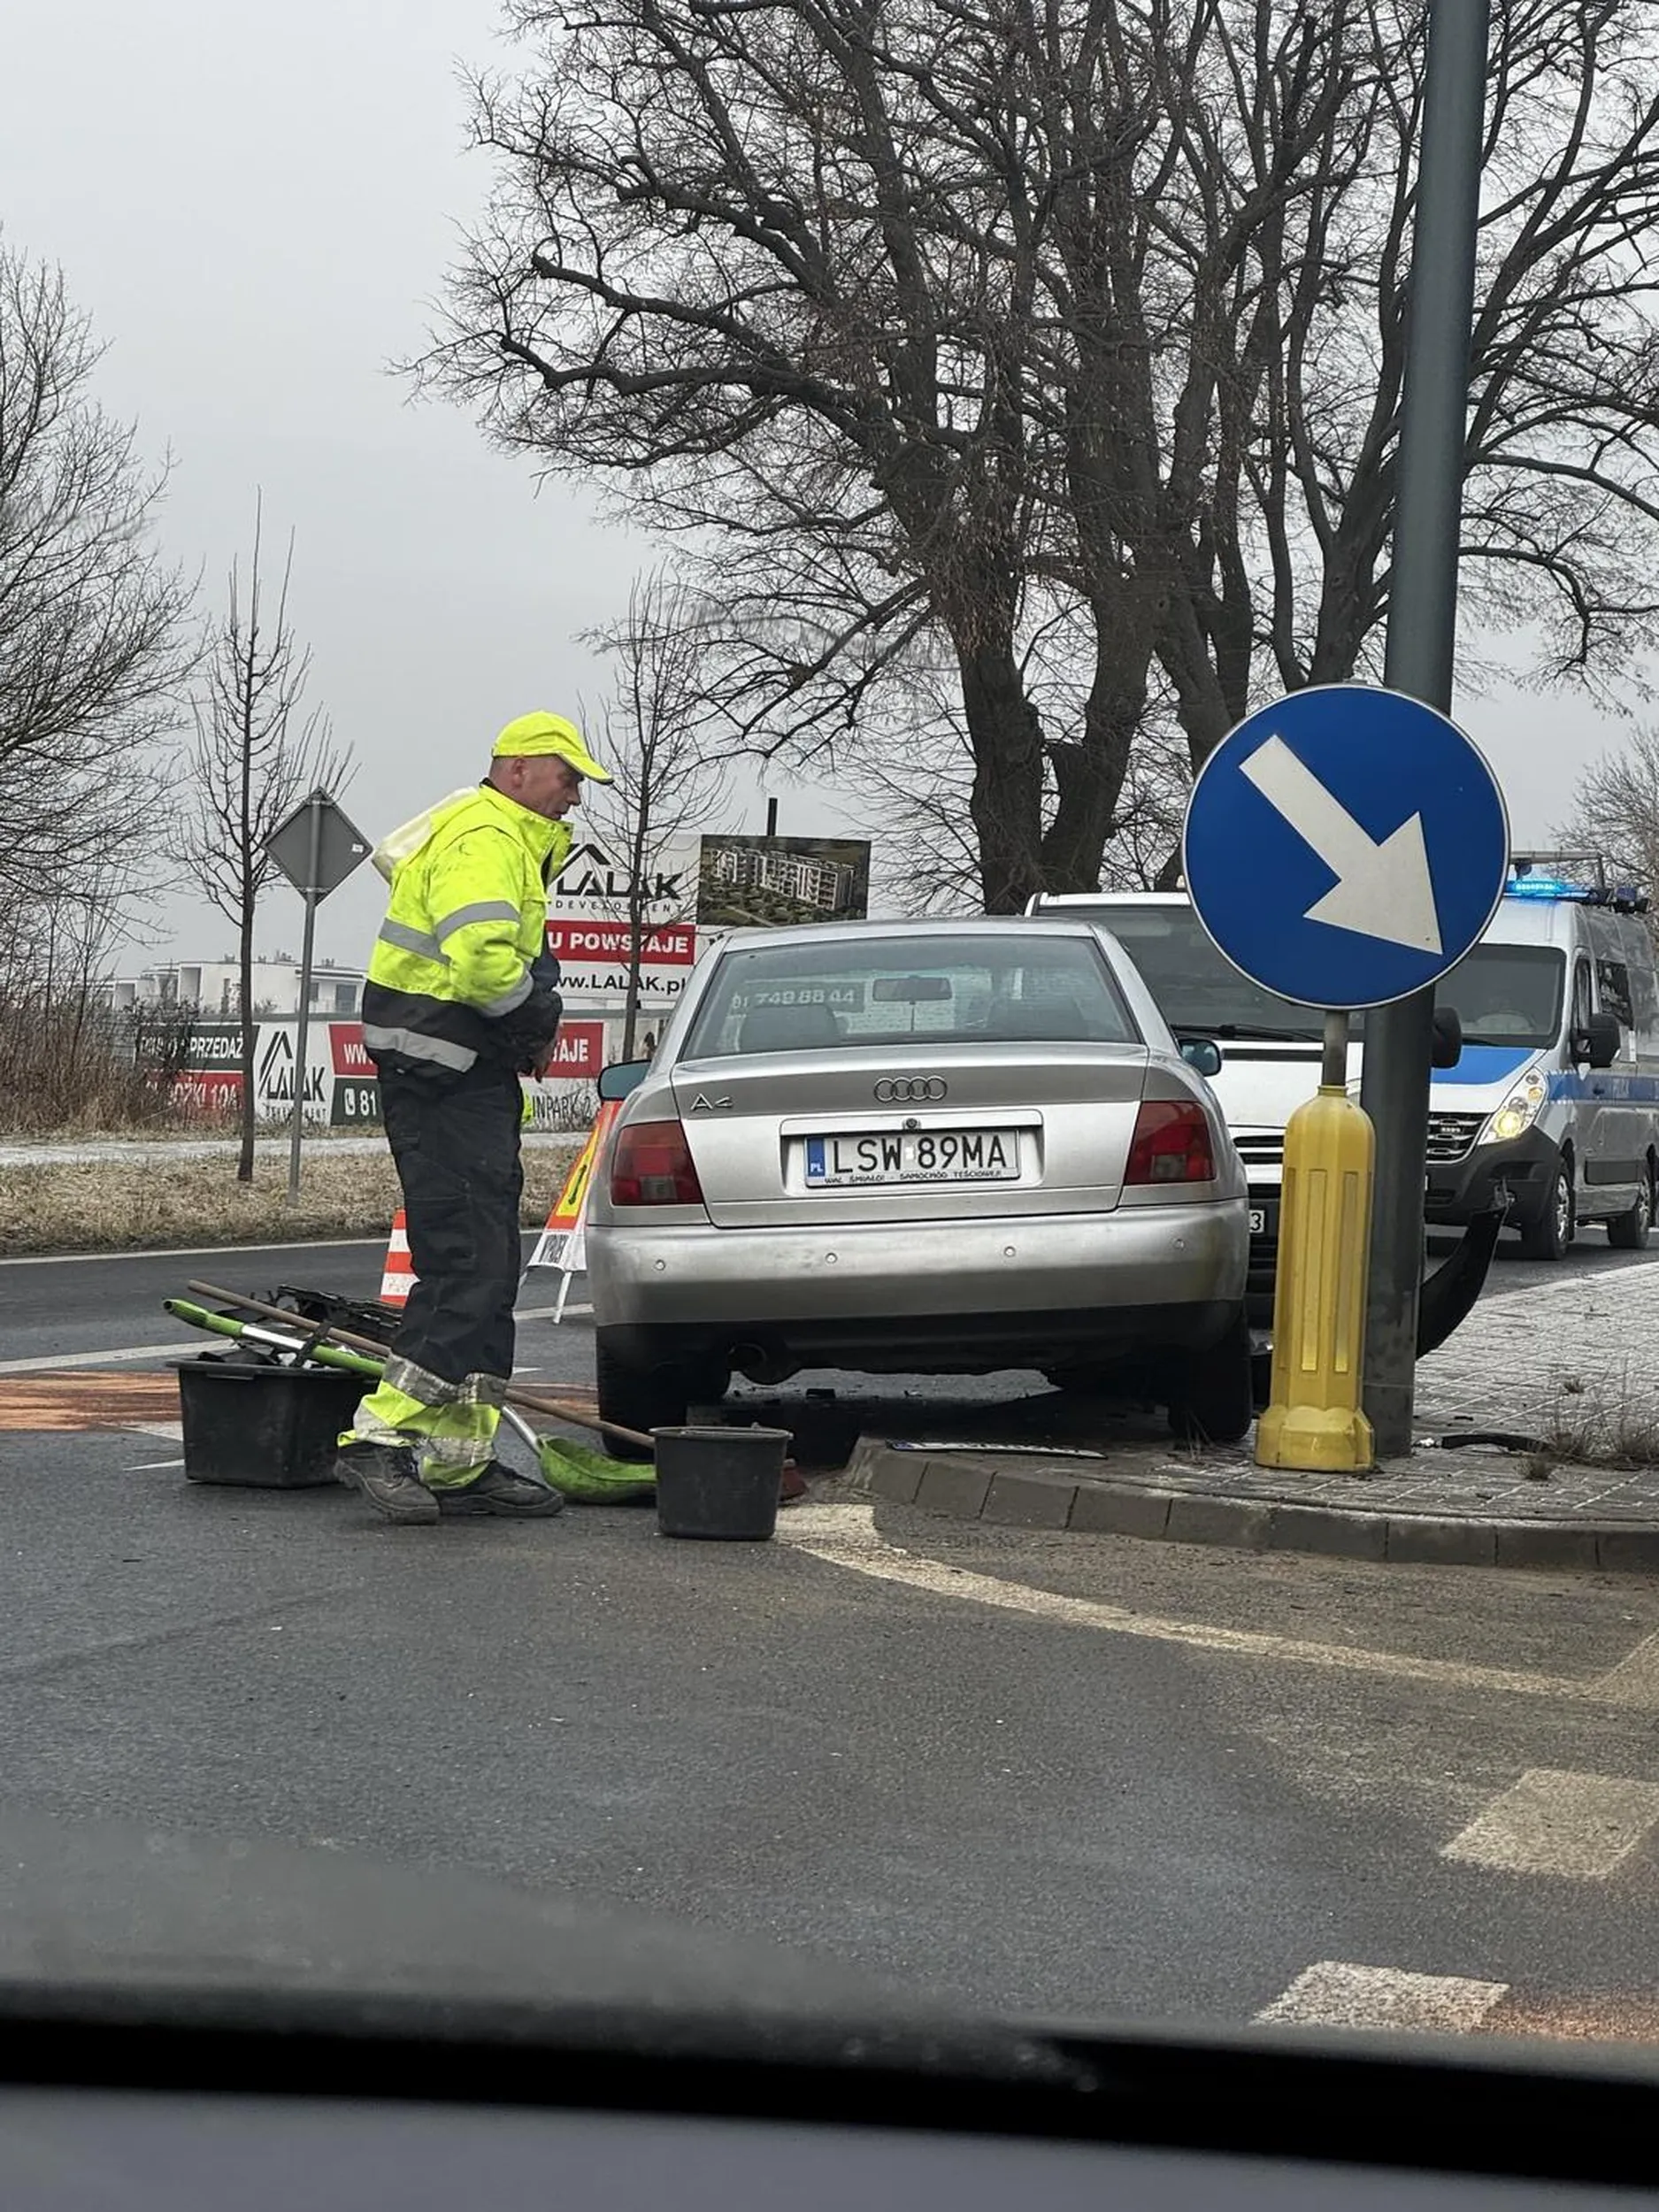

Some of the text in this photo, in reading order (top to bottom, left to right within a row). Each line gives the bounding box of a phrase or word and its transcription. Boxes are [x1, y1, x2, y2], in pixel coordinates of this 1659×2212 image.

[557, 871, 683, 900] LALAK
[548, 932, 562, 949] U
[267, 1066, 325, 1102] LALAK
[360, 1090, 377, 1116] 81
[533, 1095, 579, 1119] INPARK
[690, 1093, 733, 1110] A4
[833, 1135, 1007, 1173] LSW 89MA
[810, 1164, 824, 1172] PL
[1250, 1212, 1261, 1231] 3
